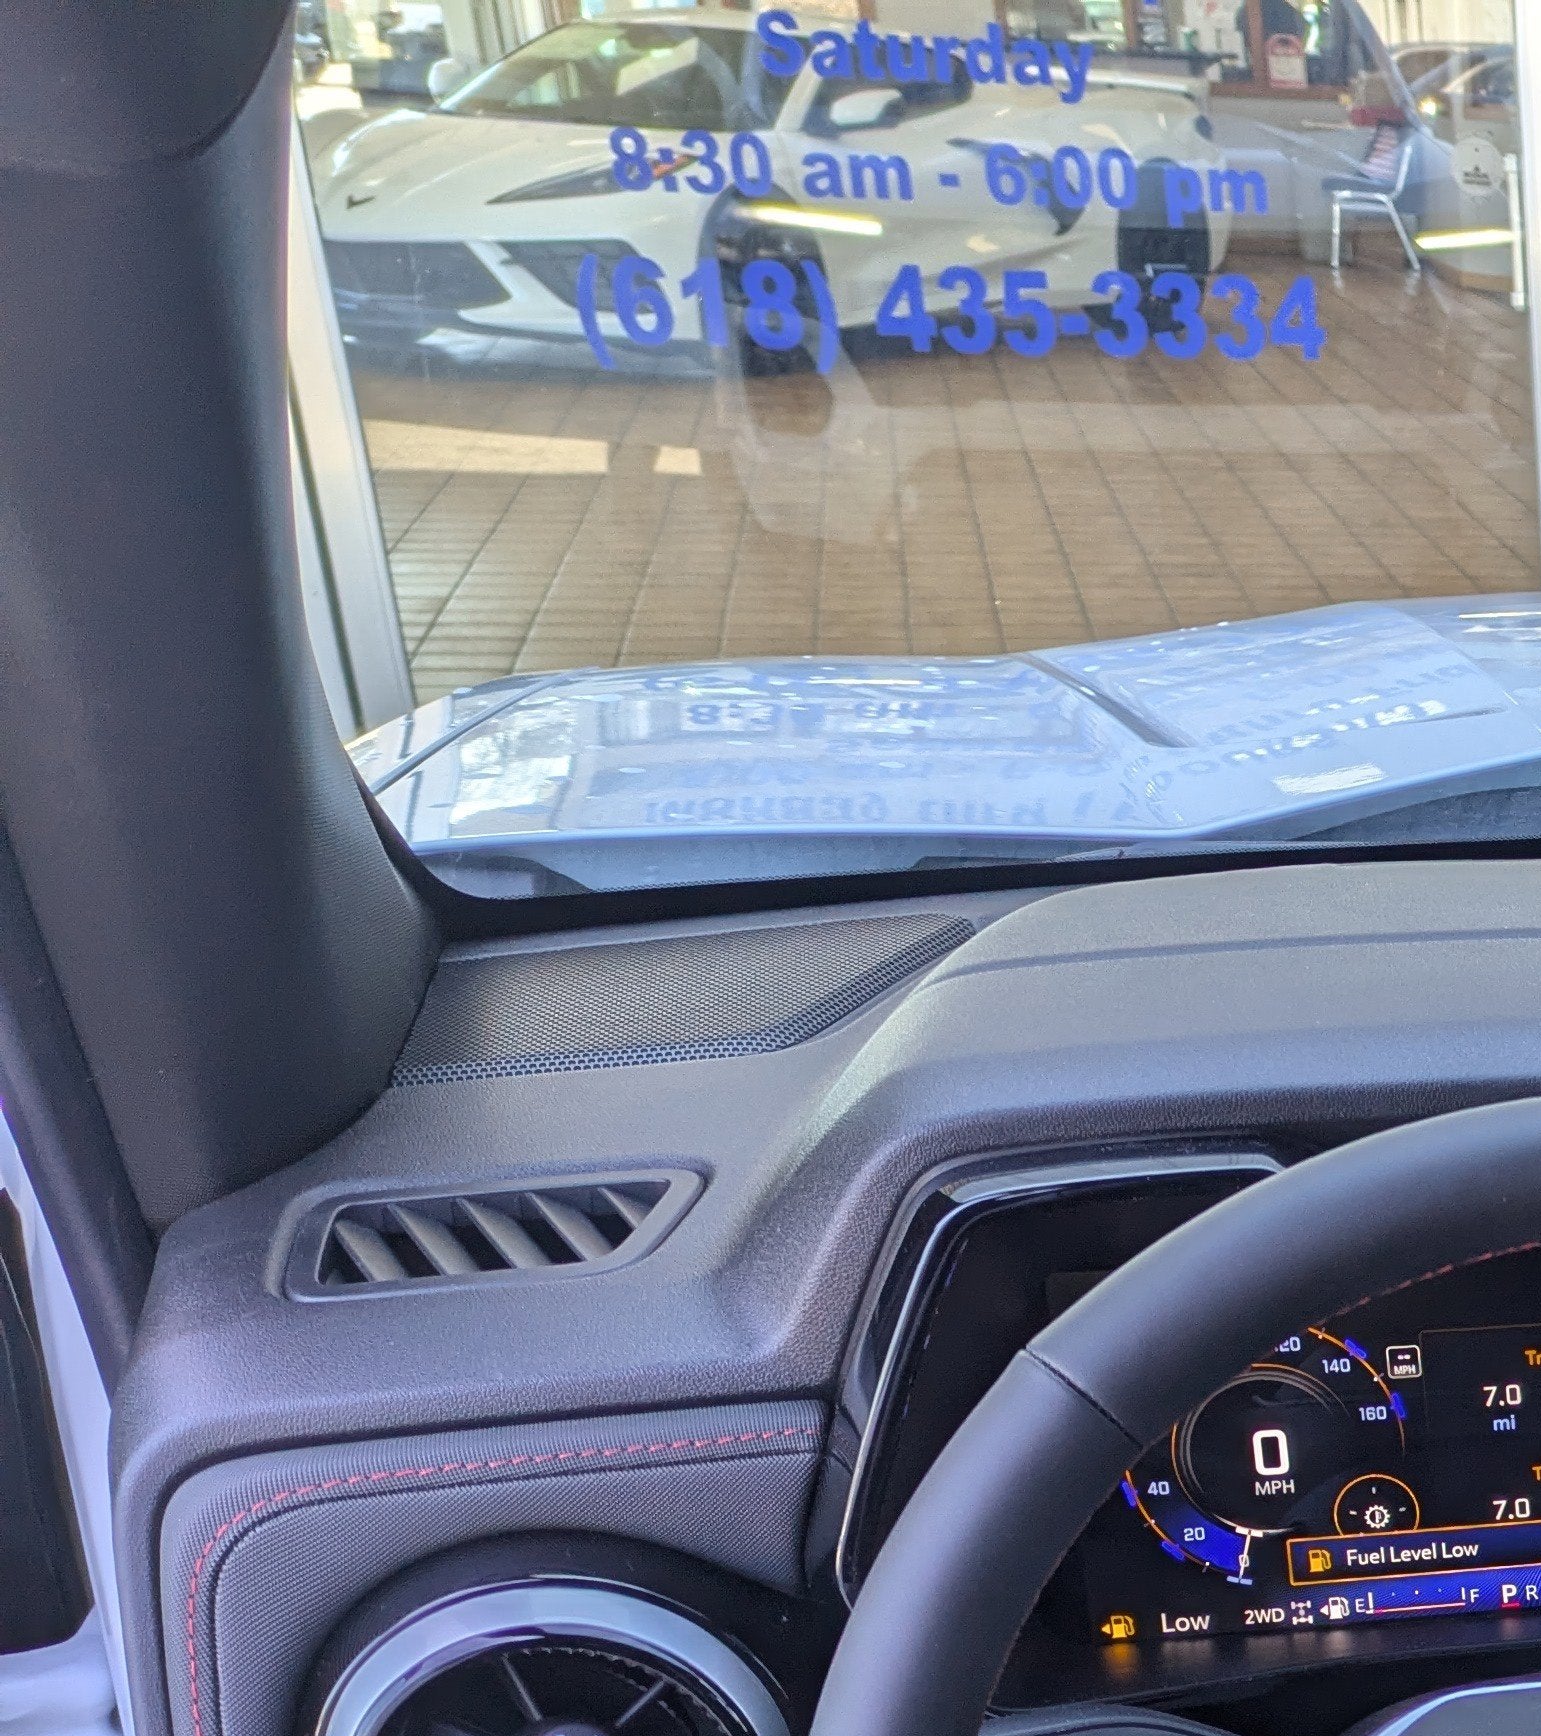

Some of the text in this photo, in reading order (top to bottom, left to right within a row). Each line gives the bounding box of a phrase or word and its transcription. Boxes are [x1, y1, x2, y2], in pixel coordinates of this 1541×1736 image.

[756, 10, 1096, 104] Saturday
[611, 126, 1268, 228] 8:30 am 6:00 pm
[576, 252, 1327, 374] (618) 435-3334
[1321, 1357, 1351, 1375] 140
[1394, 1364, 1416, 1375] MPH
[1483, 1383, 1523, 1407] 7.0
[1358, 1405, 1388, 1422] 160
[1492, 1415, 1517, 1431] mi
[1252, 1428, 1290, 1477] 0
[1147, 1481, 1170, 1497] 40
[1255, 1479, 1295, 1497] MPH
[1492, 1498, 1531, 1521] 7.0
[1183, 1525, 1206, 1543] 20
[1346, 1540, 1479, 1567] Fuel Level Low
[1355, 1588, 1480, 1613] E F
[1502, 1584, 1518, 1604] P
[1526, 1583, 1539, 1599] R
[1160, 1612, 1211, 1634] Low
[1244, 1607, 1286, 1626] 2WD
